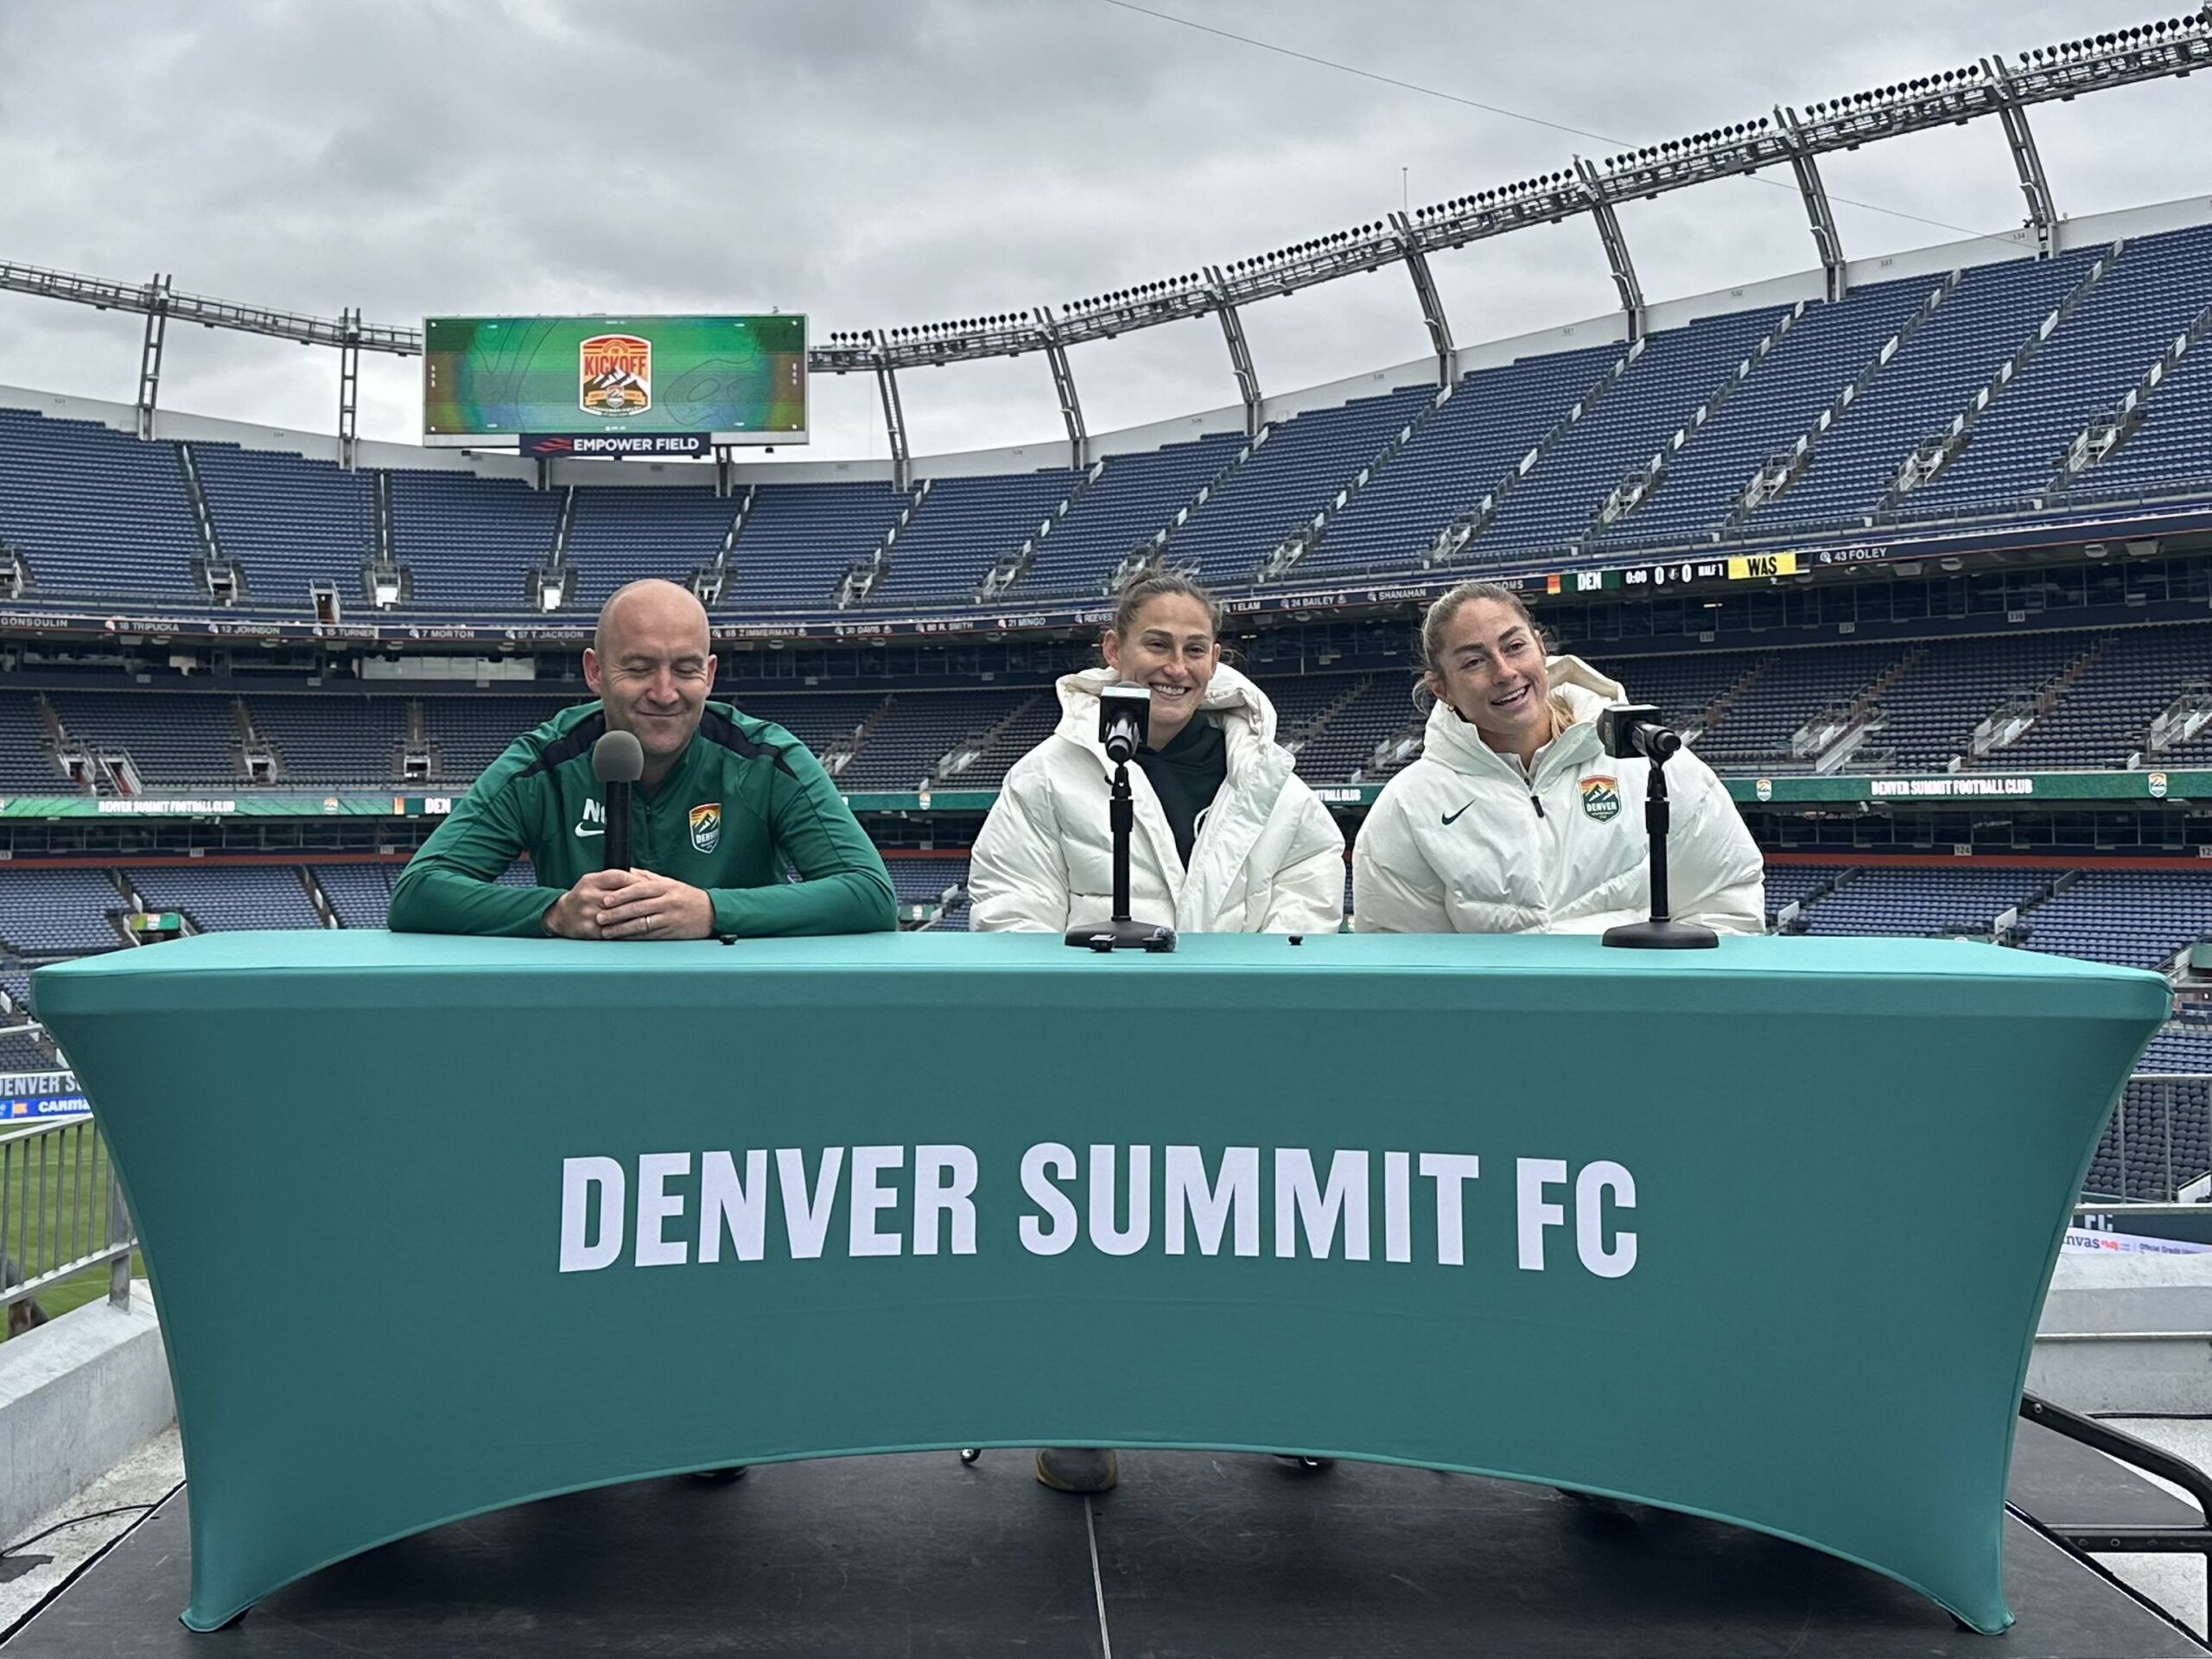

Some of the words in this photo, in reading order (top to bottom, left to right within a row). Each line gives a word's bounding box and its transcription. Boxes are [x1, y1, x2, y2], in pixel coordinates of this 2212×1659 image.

[584, 355, 647, 376] KICKOFF
[573, 439, 652, 451] EMPOWER
[656, 437, 700, 450] FIELD
[1834, 551, 1847, 562] 43
[1849, 547, 1888, 560] FOLEY
[1577, 571, 1602, 591] DEN
[1625, 570, 1647, 584] 0:00
[1655, 566, 1665, 585] 0
[1681, 563, 1692, 582] 0
[1747, 556, 1777, 576] WAS
[1378, 588, 1427, 601] SHANAHAN
[1237, 601, 1262, 612] ELAM
[1302, 596, 1335, 607] BAILEY
[0, 617, 68, 627] GONSOULIN
[1007, 619, 1017, 627] 21
[1018, 617, 1046, 626] MINGO
[1084, 613, 1114, 622] REEVES
[132, 621, 180, 632] TRIPUCKA
[221, 626, 232, 634] 12
[234, 626, 281, 635] JOHNSON
[338, 628, 375, 638] TURNER
[430, 629, 475, 639] MORTON
[539, 630, 585, 639] JACKSON
[739, 628, 795, 638] ZIMMERMAN
[1871, 780, 1910, 796] DENVER
[1910, 779, 1953, 795] SUMMIT
[1953, 779, 2005, 794] FOOTBALL
[2005, 779, 2032, 794] CLUB
[99, 801, 132, 813] DENVER
[133, 800, 169, 812] SUMMIT
[170, 800, 213, 812] FOOTBALL
[212, 800, 236, 812] CLUB
[424, 798, 451, 814] DEN
[1586, 801, 1618, 812] DENVER
[1955, 847, 1971, 856] 124
[38, 1098, 90, 1113] CARMA
[560, 1146, 977, 1272] DENVER
[1020, 1143, 1478, 1265] SUMMIT
[1517, 1159, 1637, 1277] FC
[2064, 1235, 2101, 1249] nvas
